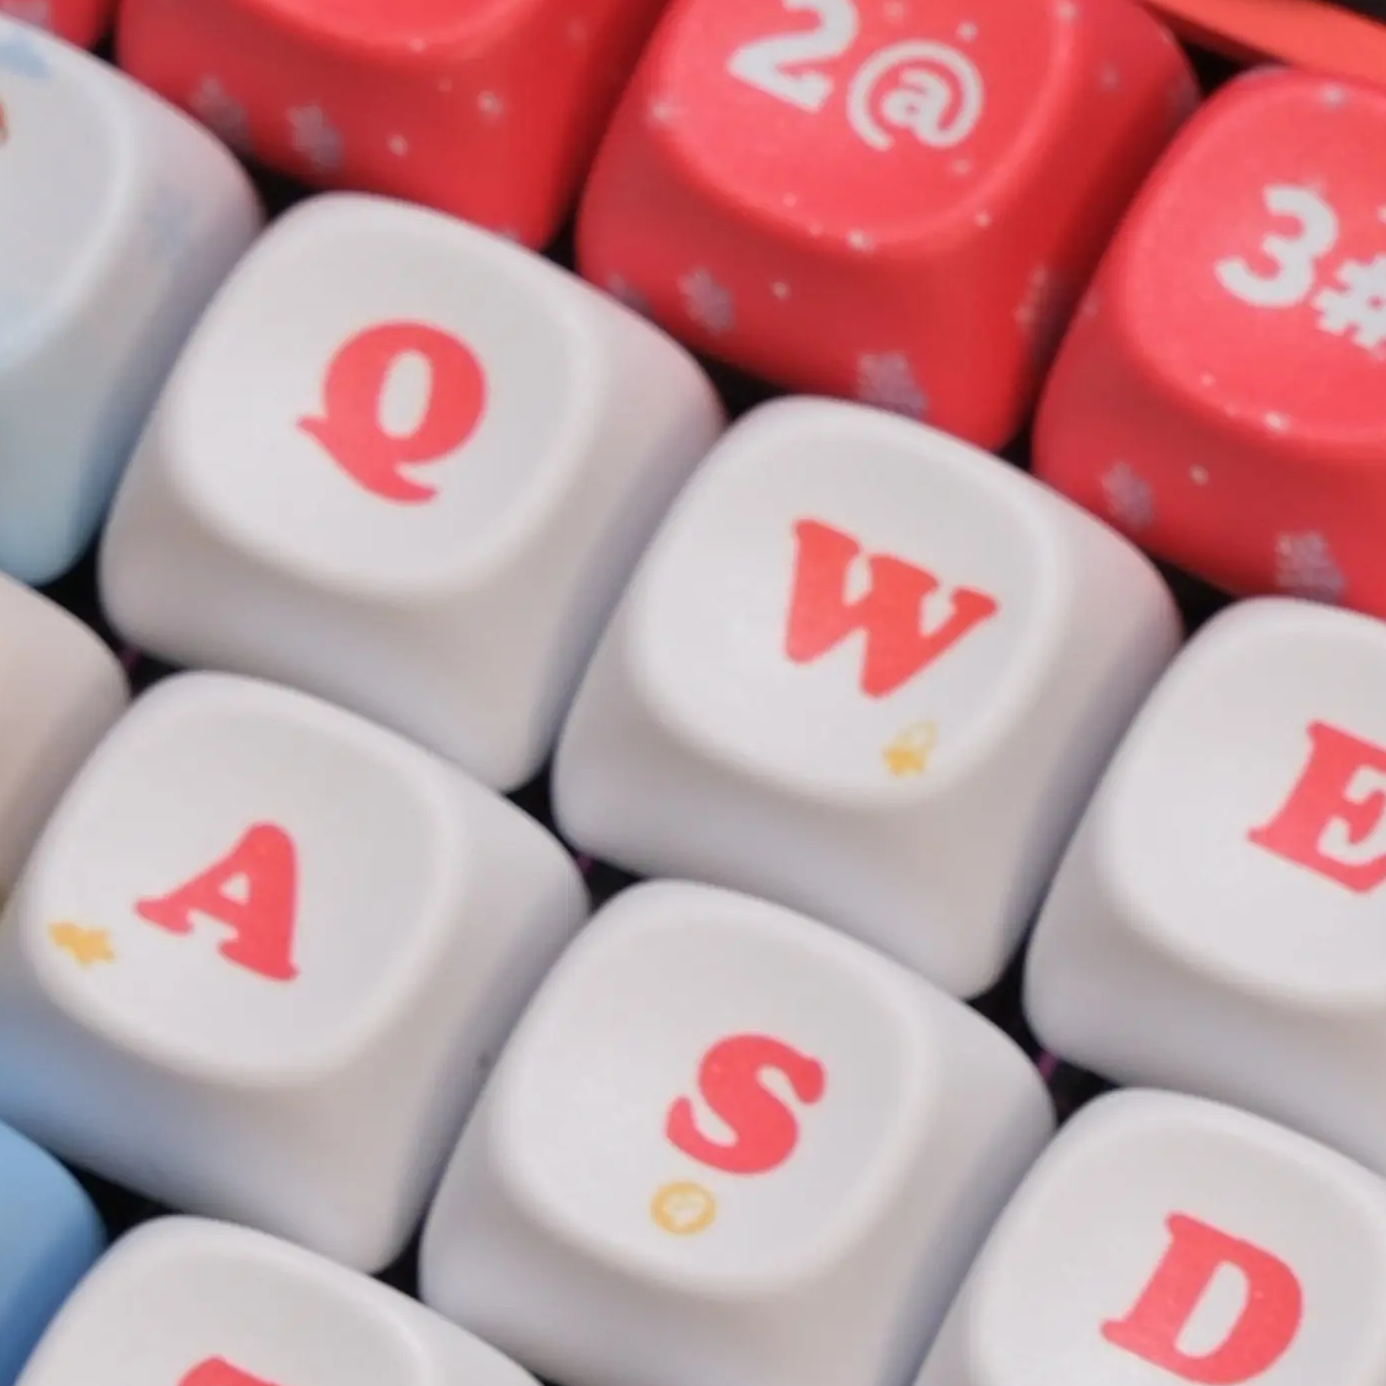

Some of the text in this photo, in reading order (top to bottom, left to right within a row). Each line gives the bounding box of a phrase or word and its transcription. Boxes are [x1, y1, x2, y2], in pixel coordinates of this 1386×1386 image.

[299, 319, 489, 505] Q
[784, 517, 998, 699] W
[135, 821, 300, 982] A
[664, 1032, 827, 1177] S
[1101, 1211, 1305, 1386] D
